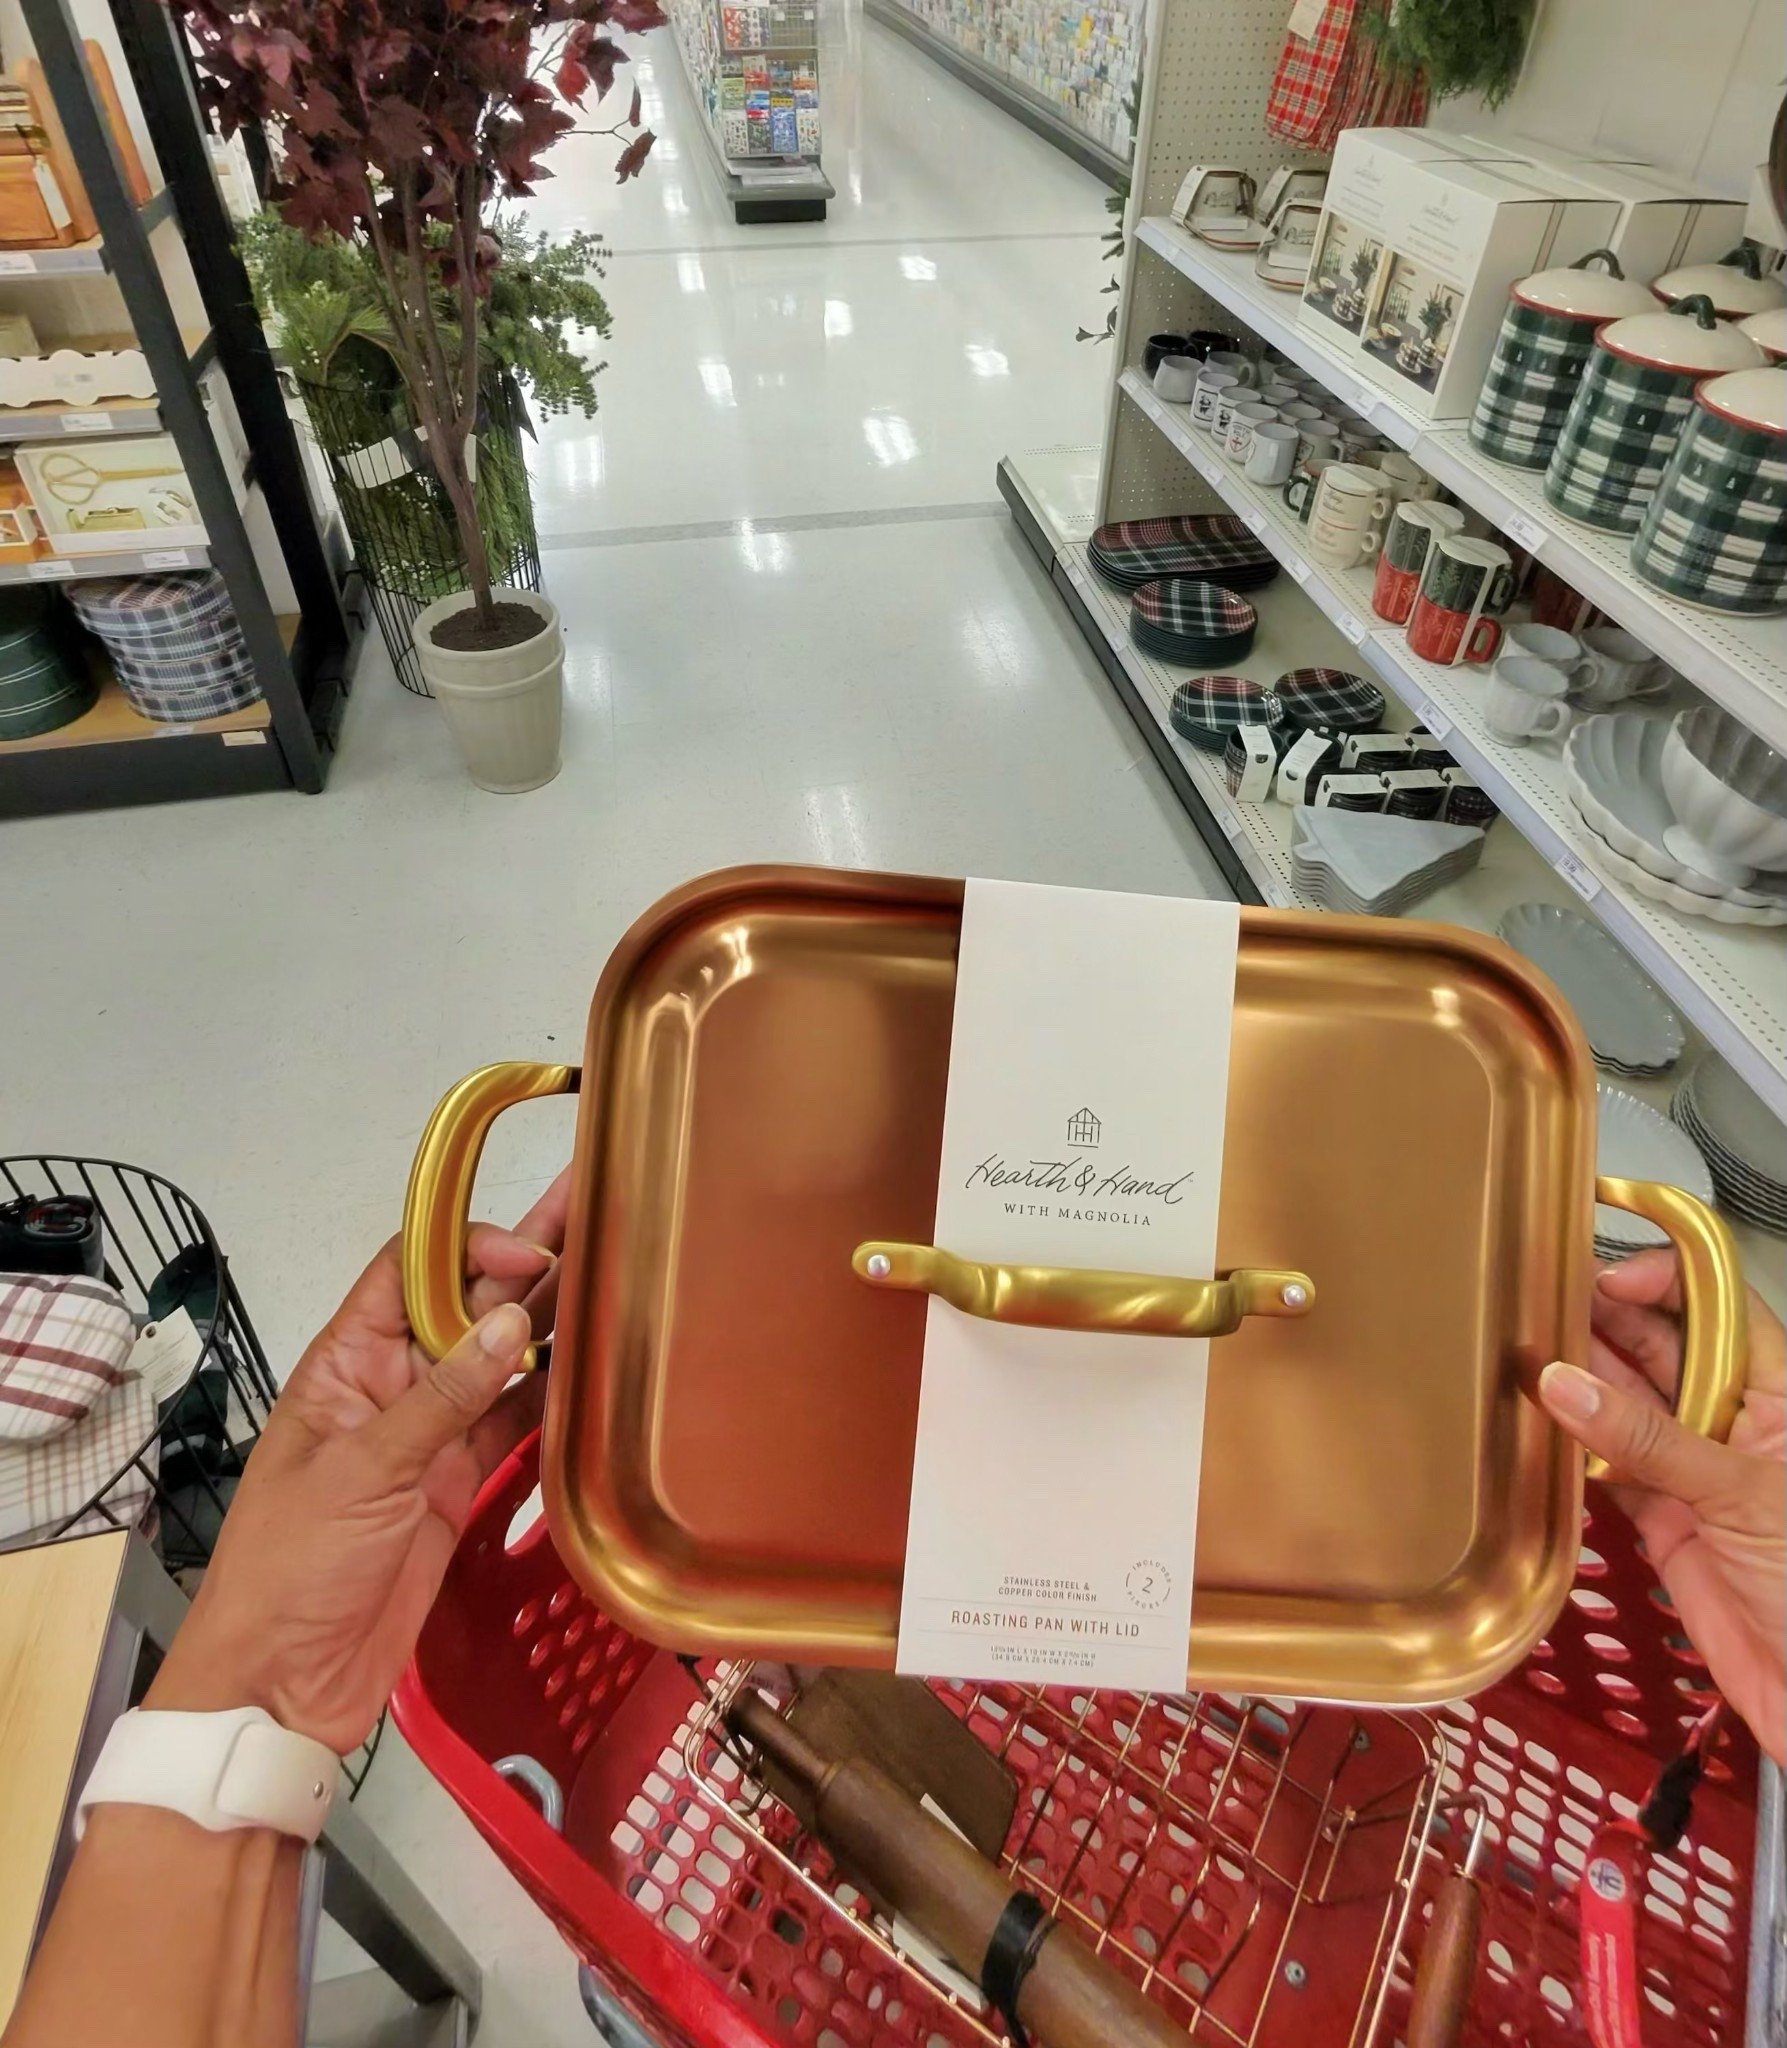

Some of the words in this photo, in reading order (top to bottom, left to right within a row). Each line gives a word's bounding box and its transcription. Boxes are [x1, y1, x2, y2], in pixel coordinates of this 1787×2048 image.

[965, 1153, 1082, 1192] Hearth
[1074, 1164, 1096, 1196] &
[1003, 1202, 1050, 1218] WITH
[1057, 1207, 1152, 1226] MAGNOLIA
[998, 1586, 1033, 1597] COPPER
[1035, 1589, 1064, 1600] COLOR
[1067, 1592, 1097, 1602] FINISH
[1003, 1576, 1051, 1588] STAINLESS
[1053, 1580, 1080, 1591] STEEL
[1083, 1582, 1090, 1591] &
[1141, 1576, 1154, 1594] 2
[951, 1610, 1028, 1629] ROASTING
[1034, 1616, 1064, 1632] PAN
[1070, 1619, 1109, 1635] WITH
[1115, 1622, 1140, 1638] LID
